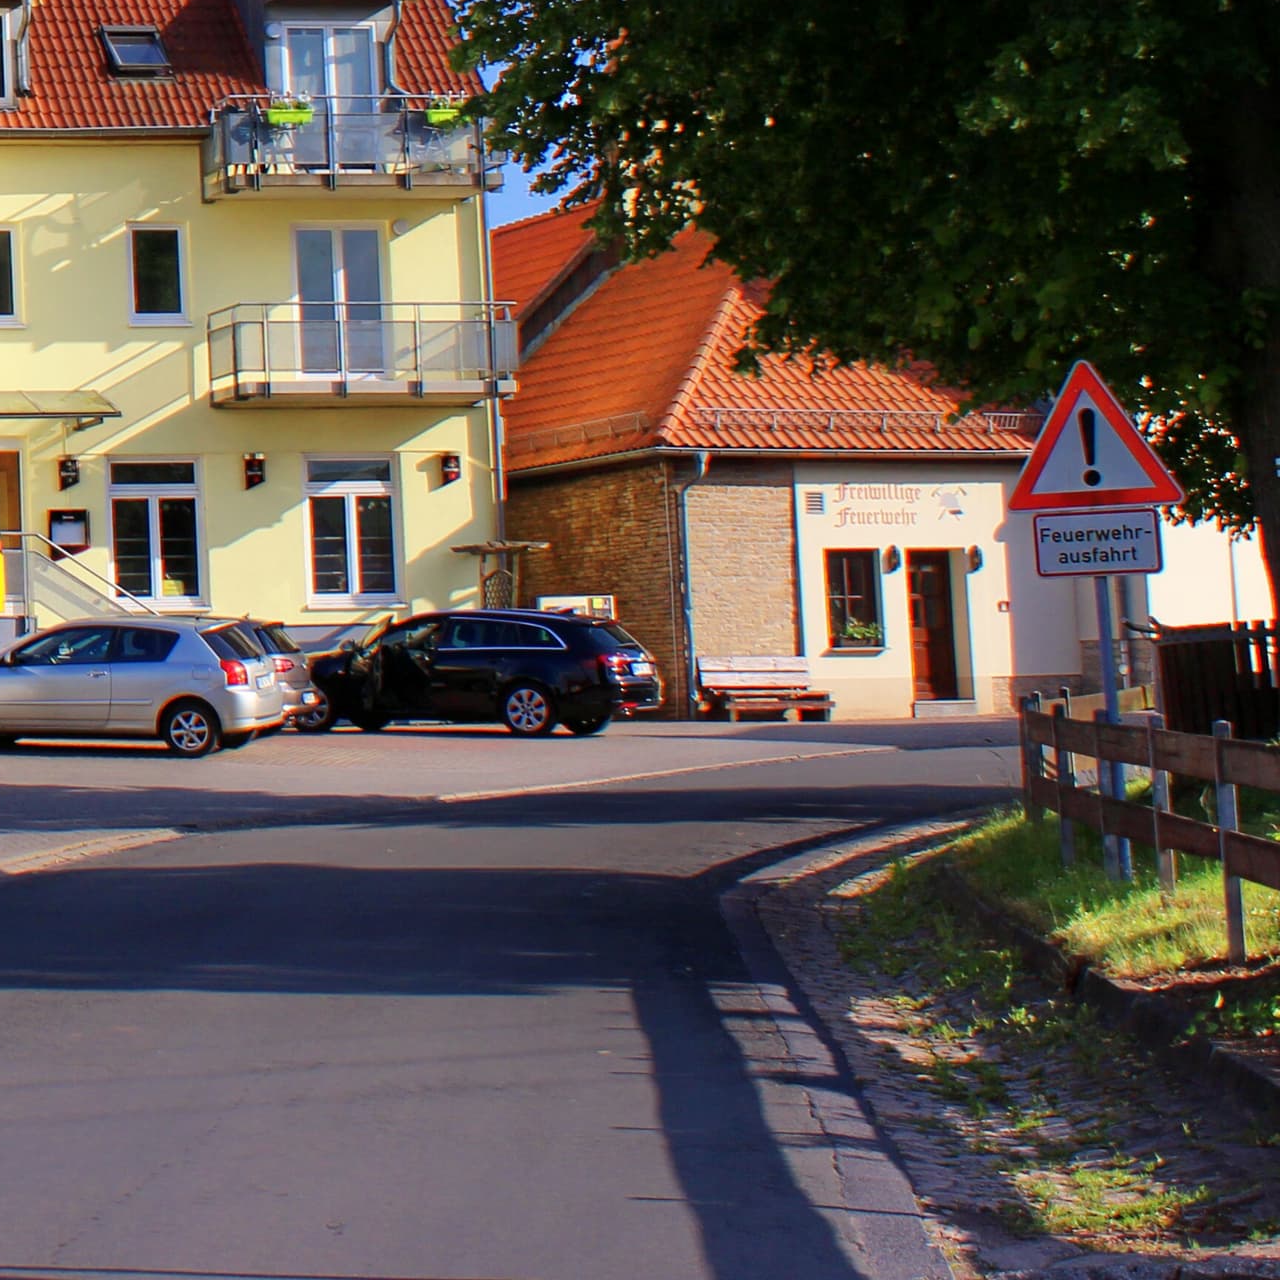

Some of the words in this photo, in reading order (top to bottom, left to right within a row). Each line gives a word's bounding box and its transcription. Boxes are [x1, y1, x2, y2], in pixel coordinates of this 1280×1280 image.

[832, 482, 921, 504] Freiwillige
[834, 507, 917, 527] Feuerwehr
[1040, 524, 1152, 543] Feuerwehr-
[1059, 546, 1137, 564] ausfahrt
